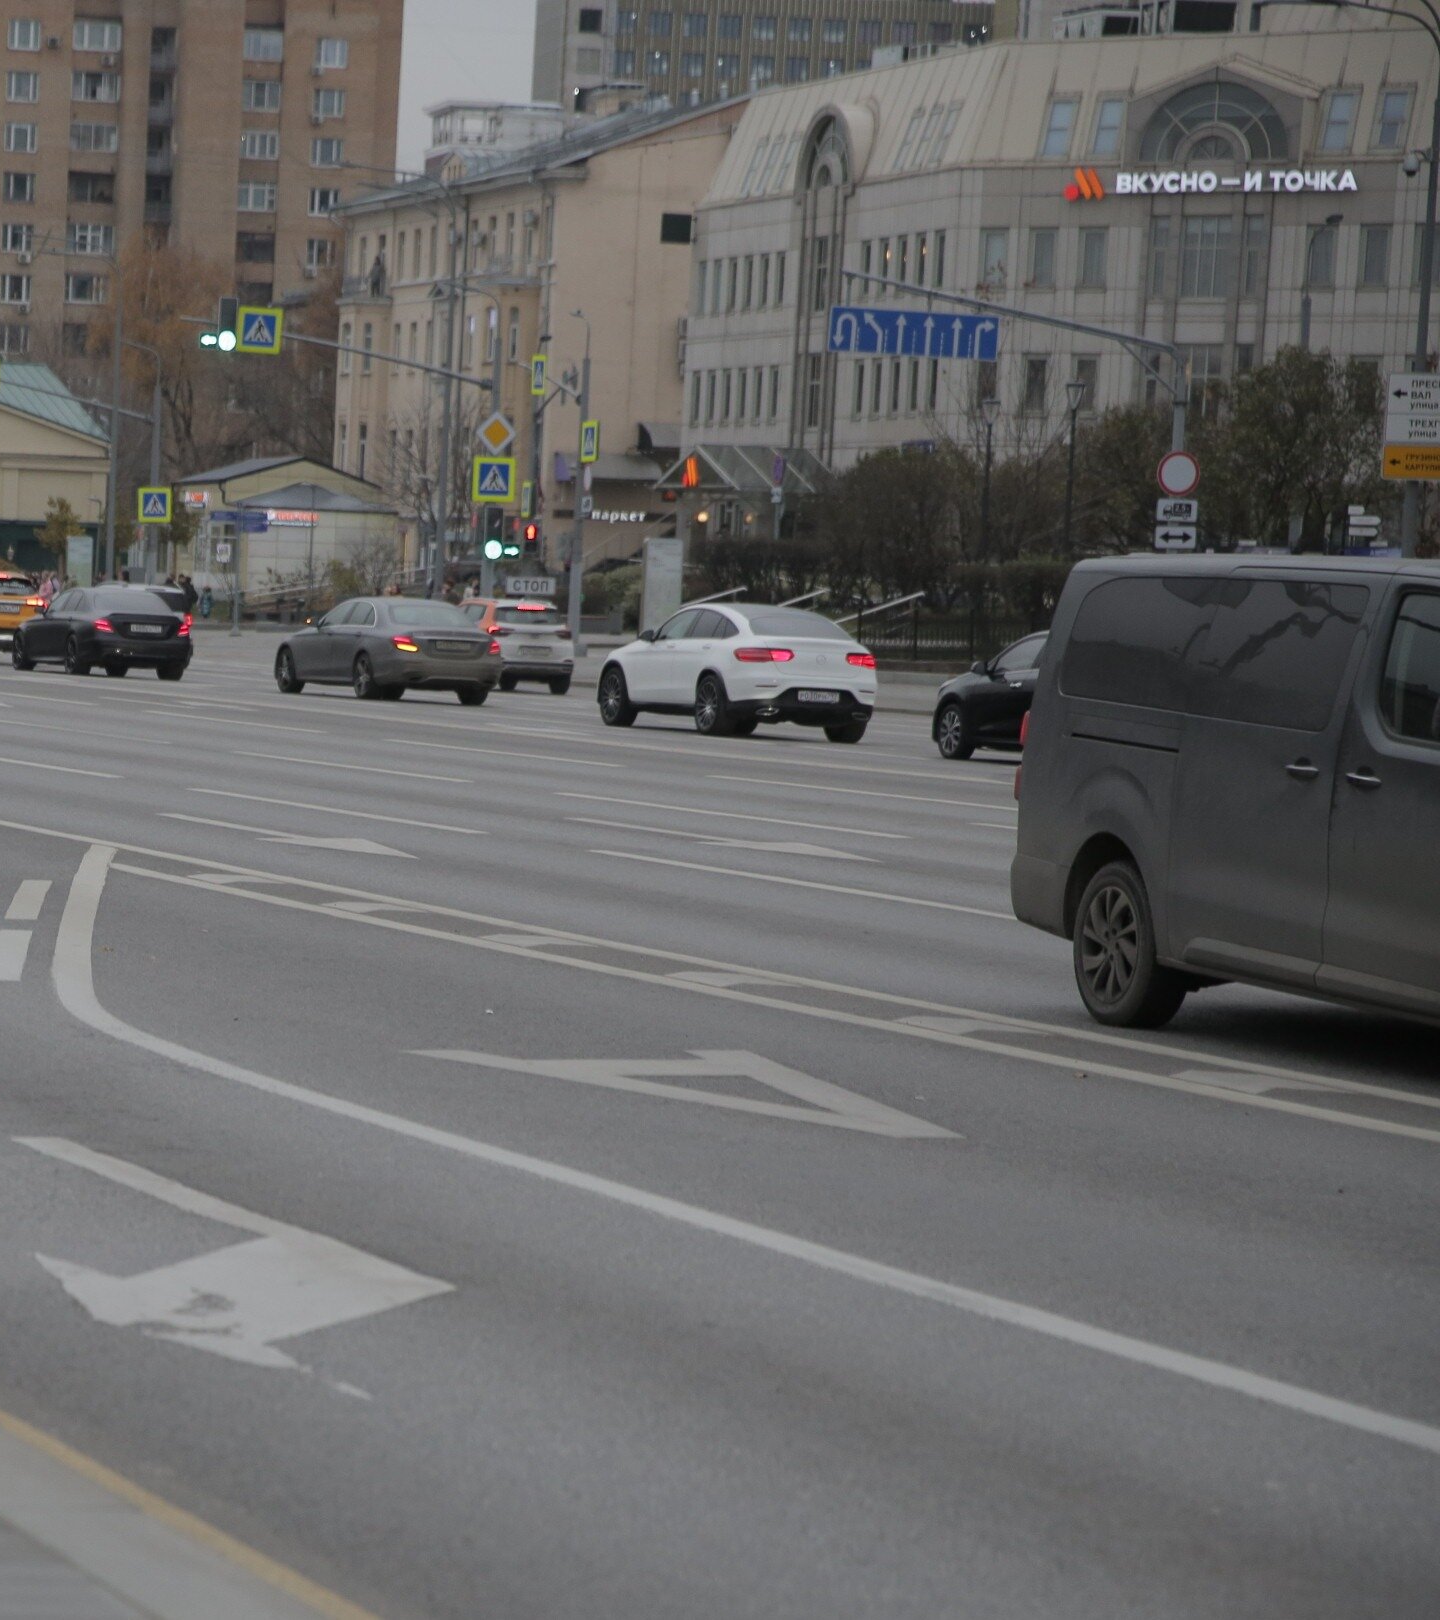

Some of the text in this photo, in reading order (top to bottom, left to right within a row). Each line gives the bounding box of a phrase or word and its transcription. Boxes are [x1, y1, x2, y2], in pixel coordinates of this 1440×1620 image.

[1116, 172, 1217, 193] ВКУСНО
[1244, 172, 1262, 192] И
[1269, 169, 1358, 192] ТОЧКА
[1411, 379, 1440, 389] ПРЕС
[1411, 391, 1431, 399] ВАЛ
[1410, 401, 1439, 410] улица
[1408, 430, 1437, 439] улица
[591, 510, 647, 524] паркет
[512, 579, 549, 592] СТОП
